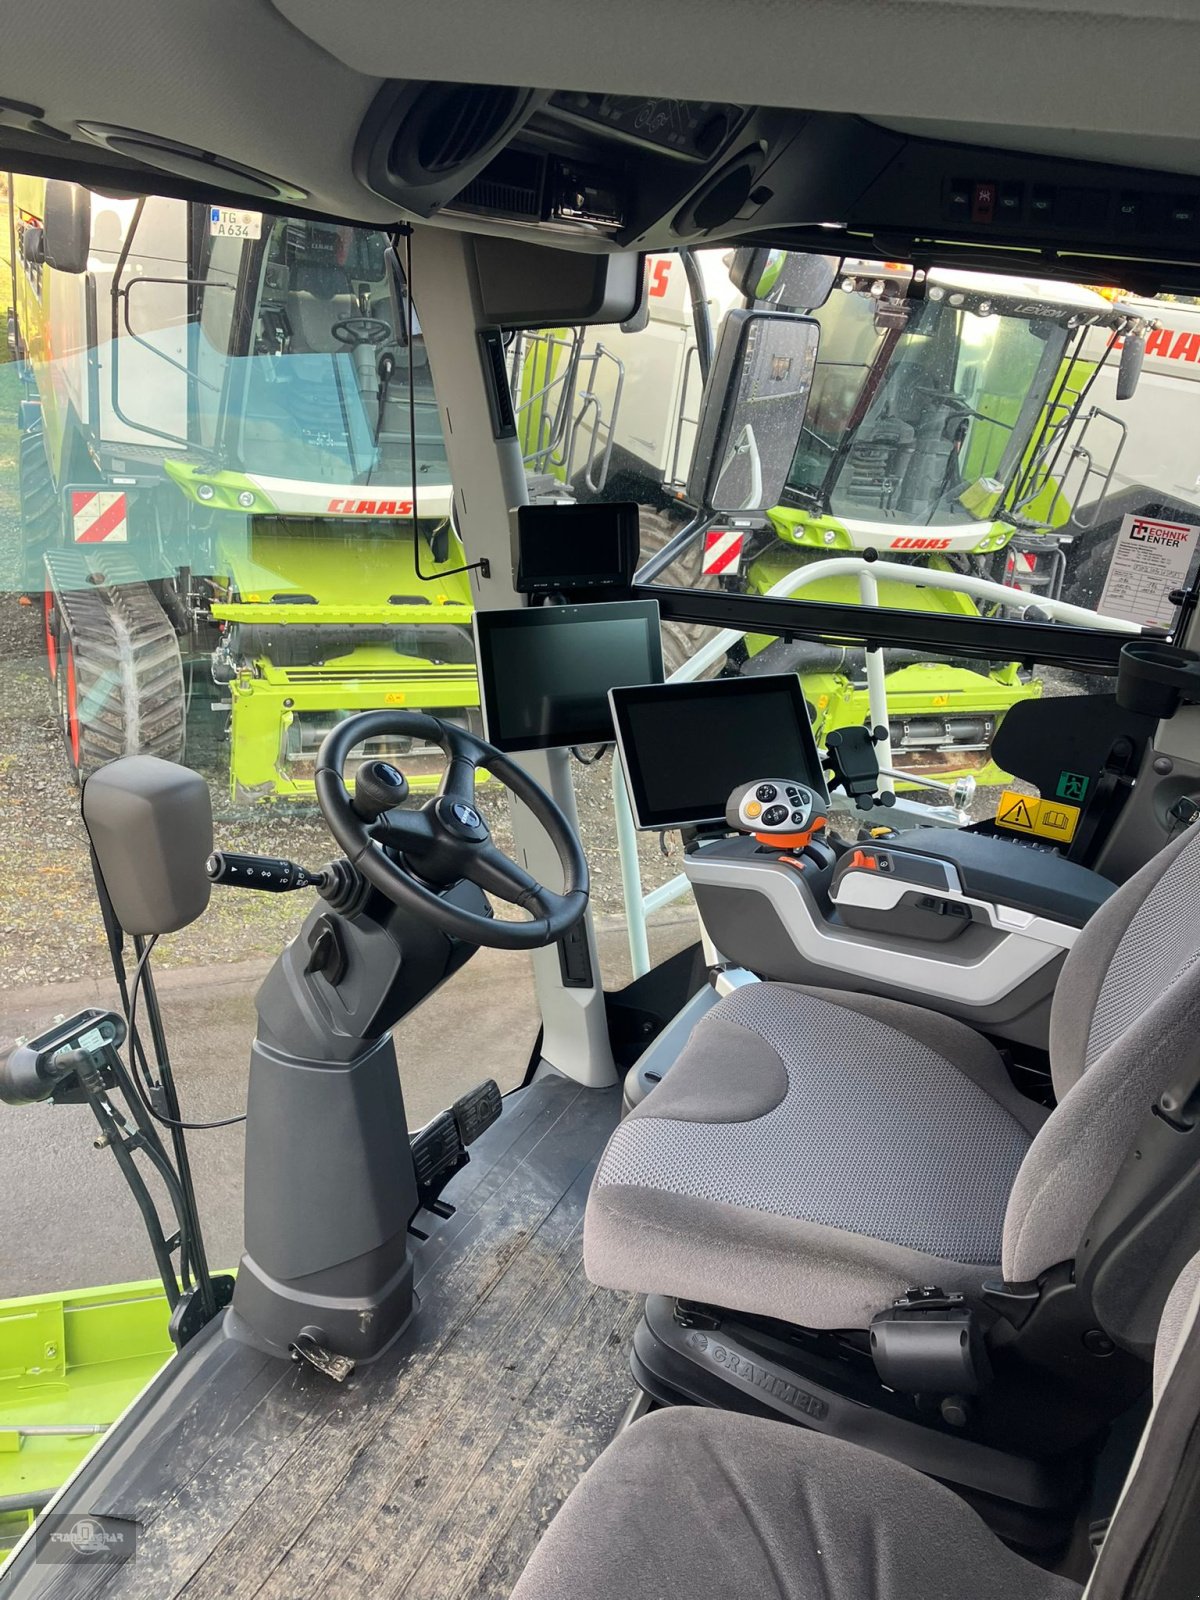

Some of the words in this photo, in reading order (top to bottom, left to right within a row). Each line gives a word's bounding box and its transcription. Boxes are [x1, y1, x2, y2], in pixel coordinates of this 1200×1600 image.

[221, 211, 237, 224] TG
[218, 223, 226, 236] A
[227, 224, 249, 237] 634
[327, 498, 413, 515] CLAAS
[889, 537, 952, 549] CLAAS
[712, 1344, 826, 1421] GRAMMER
